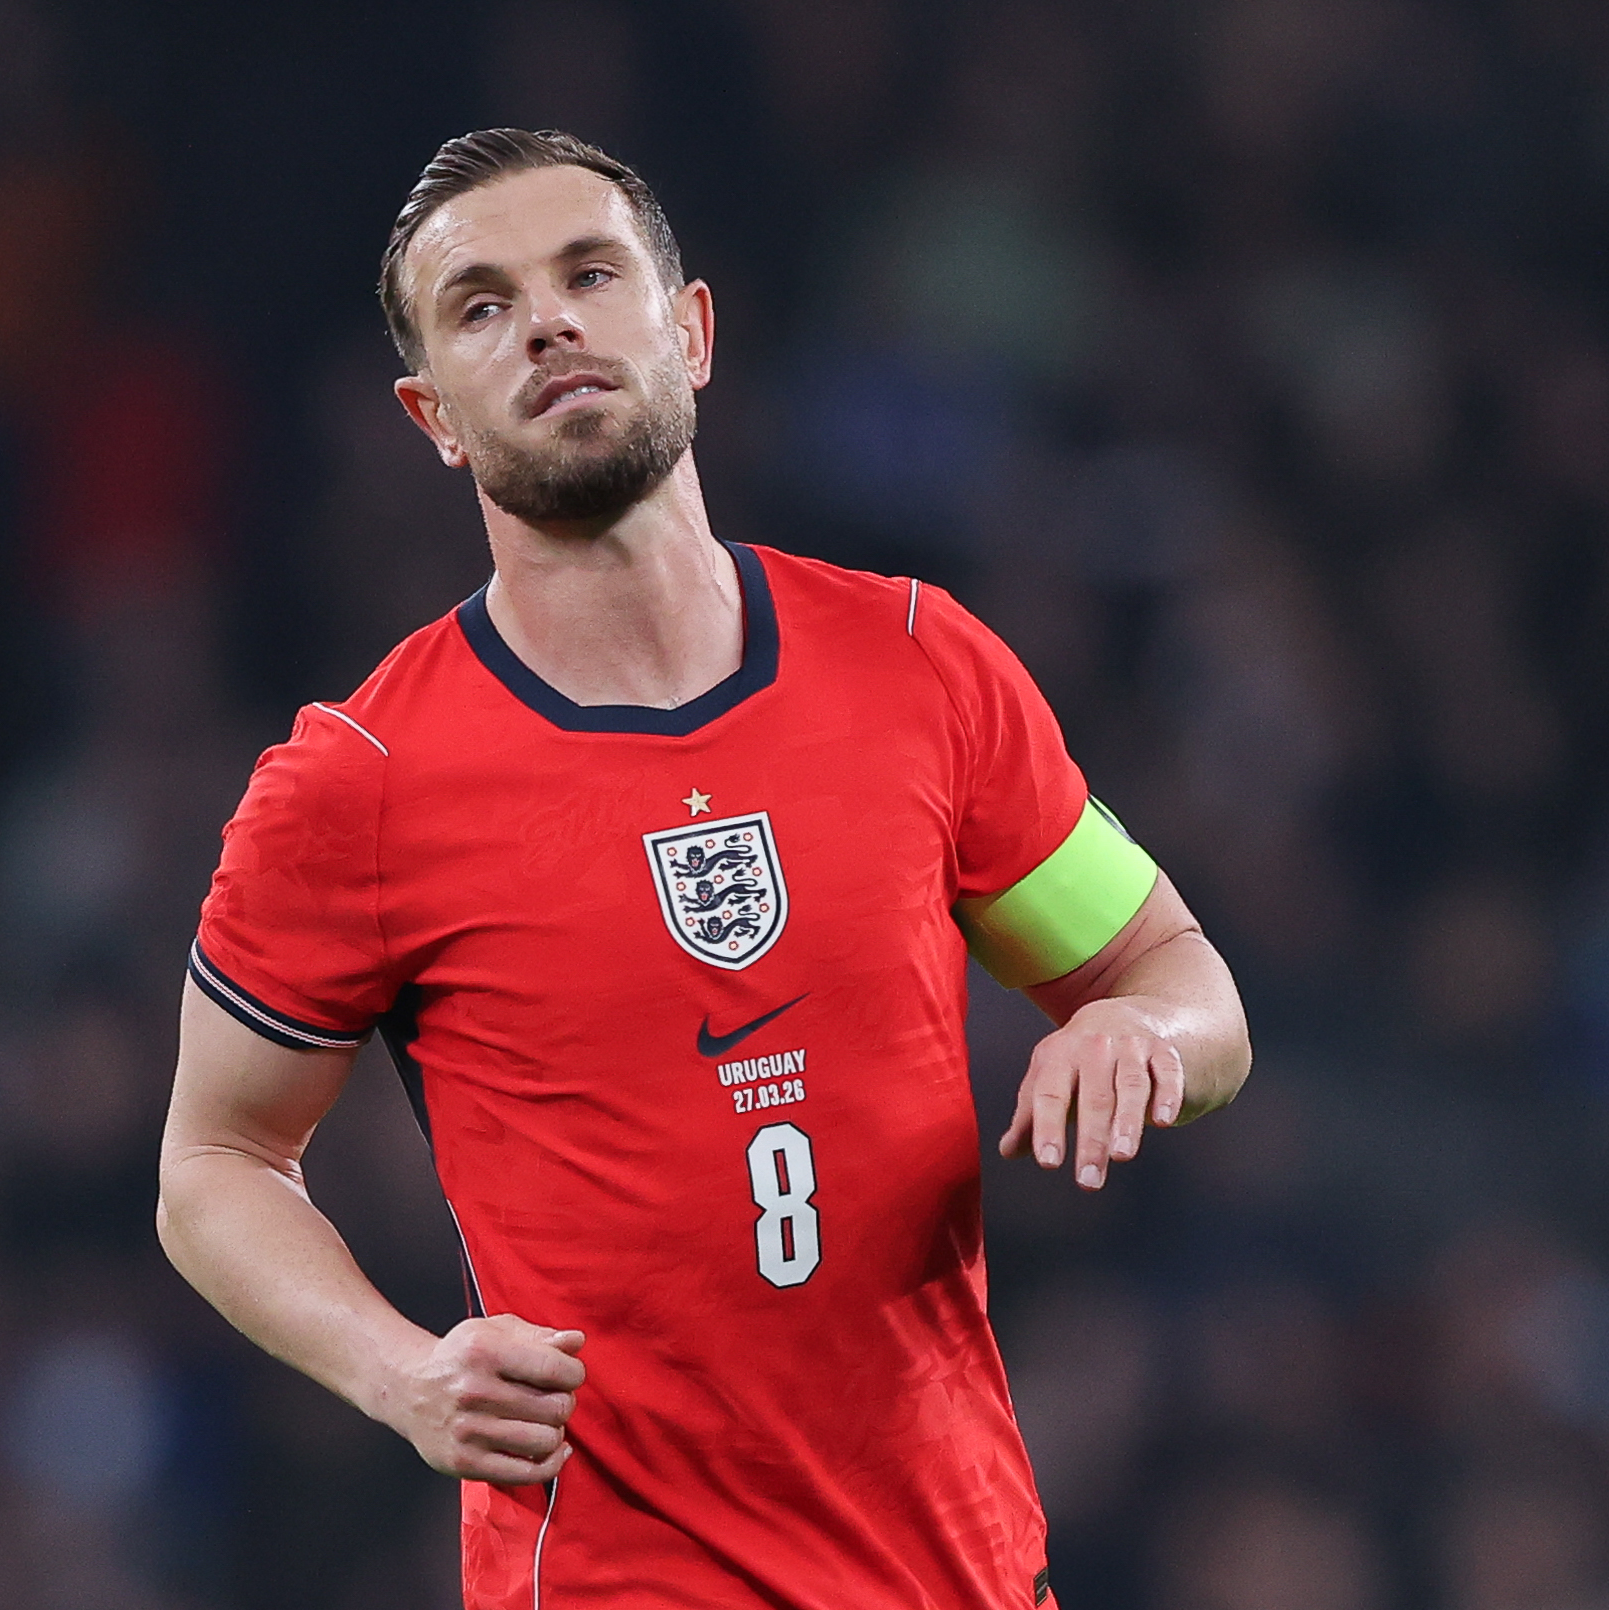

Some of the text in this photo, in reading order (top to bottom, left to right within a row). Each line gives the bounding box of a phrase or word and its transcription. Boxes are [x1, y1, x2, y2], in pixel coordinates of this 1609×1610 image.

[717, 1048, 806, 1087] URUGUAY
[733, 1078, 806, 1114] 27.03.26
[746, 1121, 822, 1289] 8
